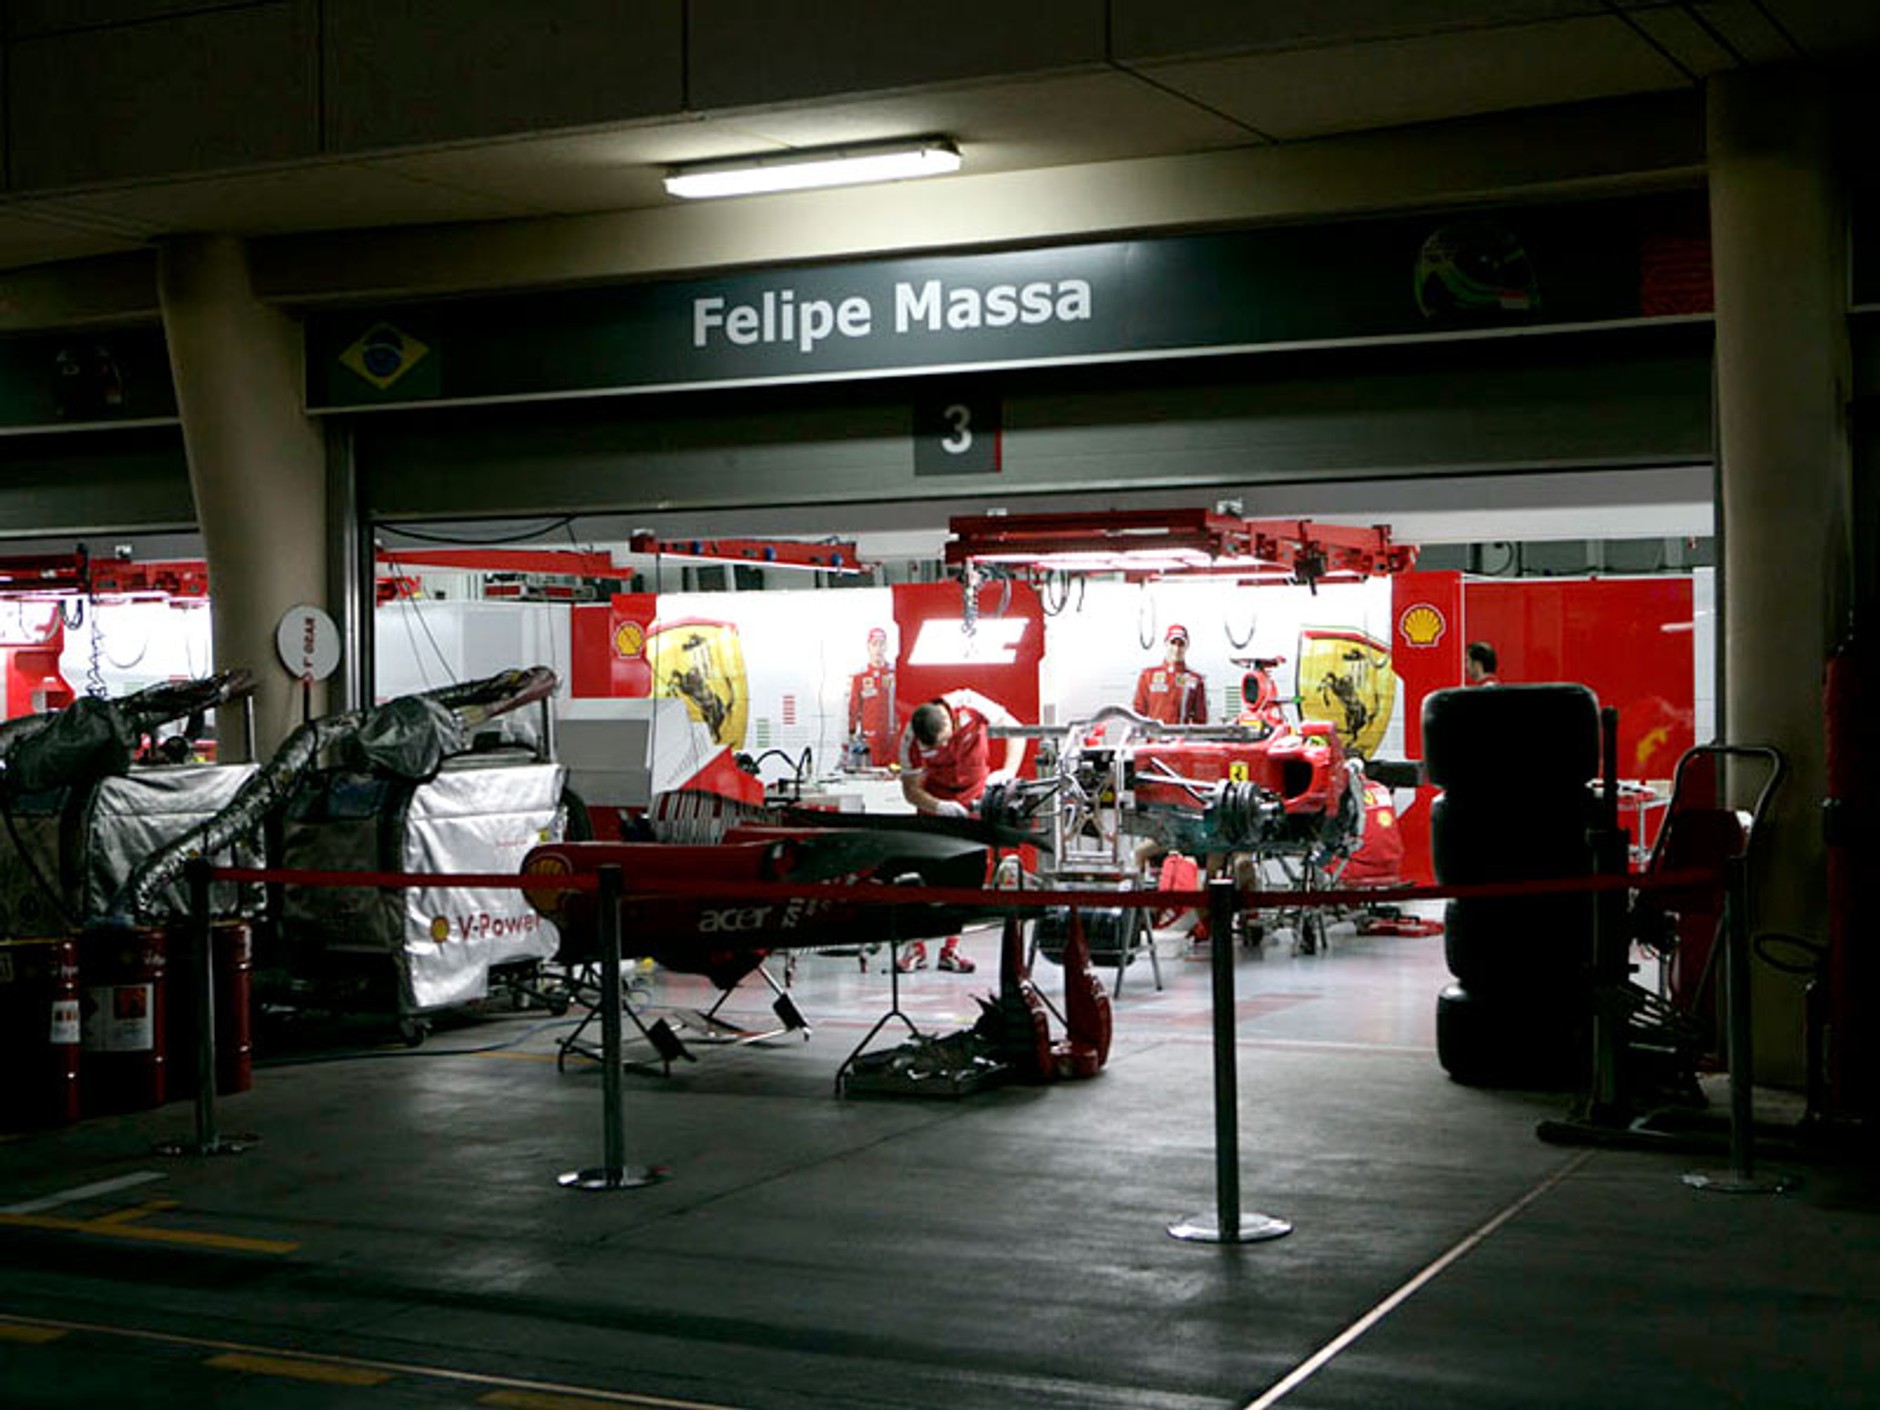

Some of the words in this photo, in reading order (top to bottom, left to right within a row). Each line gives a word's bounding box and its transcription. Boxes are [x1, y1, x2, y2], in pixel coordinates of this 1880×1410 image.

[693, 290, 871, 352] Felipe
[895, 278, 1092, 333] Massa
[941, 404, 972, 454] 3
[458, 913, 541, 940] V-Power
[697, 904, 773, 933] acer
